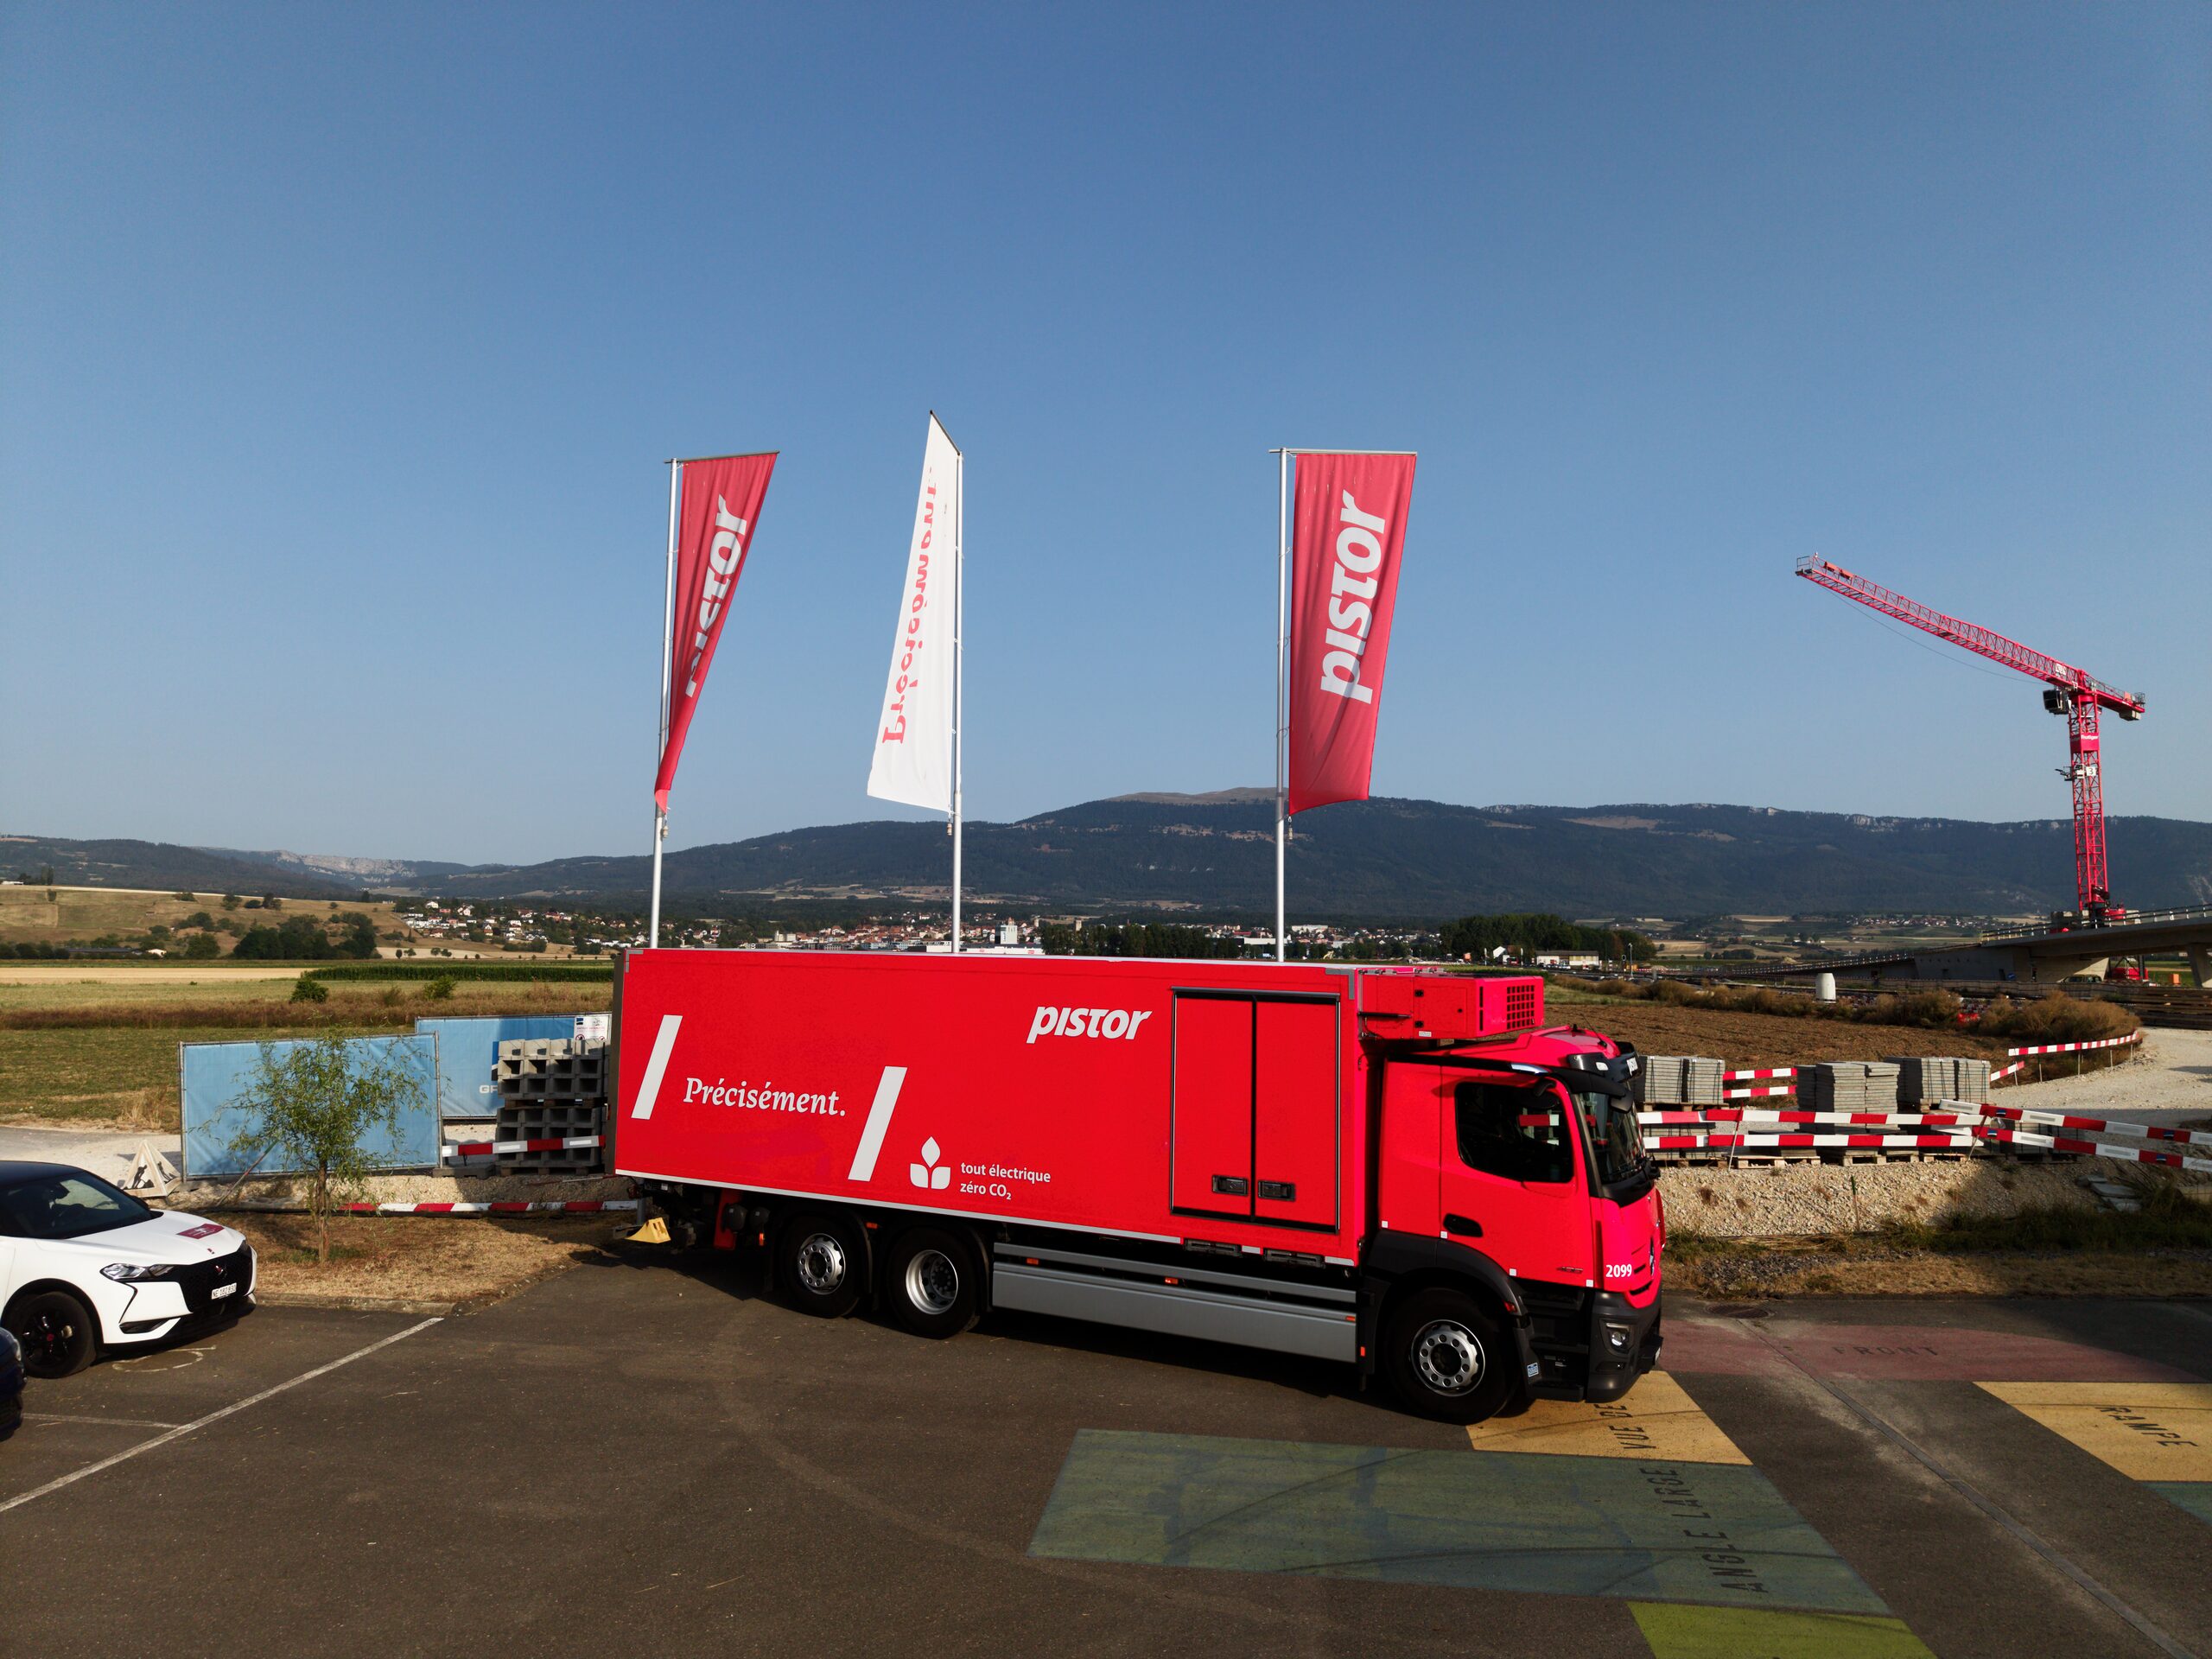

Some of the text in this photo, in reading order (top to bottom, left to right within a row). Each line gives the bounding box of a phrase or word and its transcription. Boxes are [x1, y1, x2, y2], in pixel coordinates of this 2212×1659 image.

[1320, 489, 1386, 704] pistor
[1026, 1006, 1153, 1045] pistor
[683, 1077, 847, 1117] Précisément.
[960, 1180, 986, 1195] zéro
[961, 1162, 1052, 1185] tout électrique
[1605, 1263, 1632, 1278] 2099
[1609, 1425, 1657, 1450] VUE
[2094, 1407, 2199, 1447] RAMPE
[1638, 1467, 1770, 1594] ANGLE LARGE
